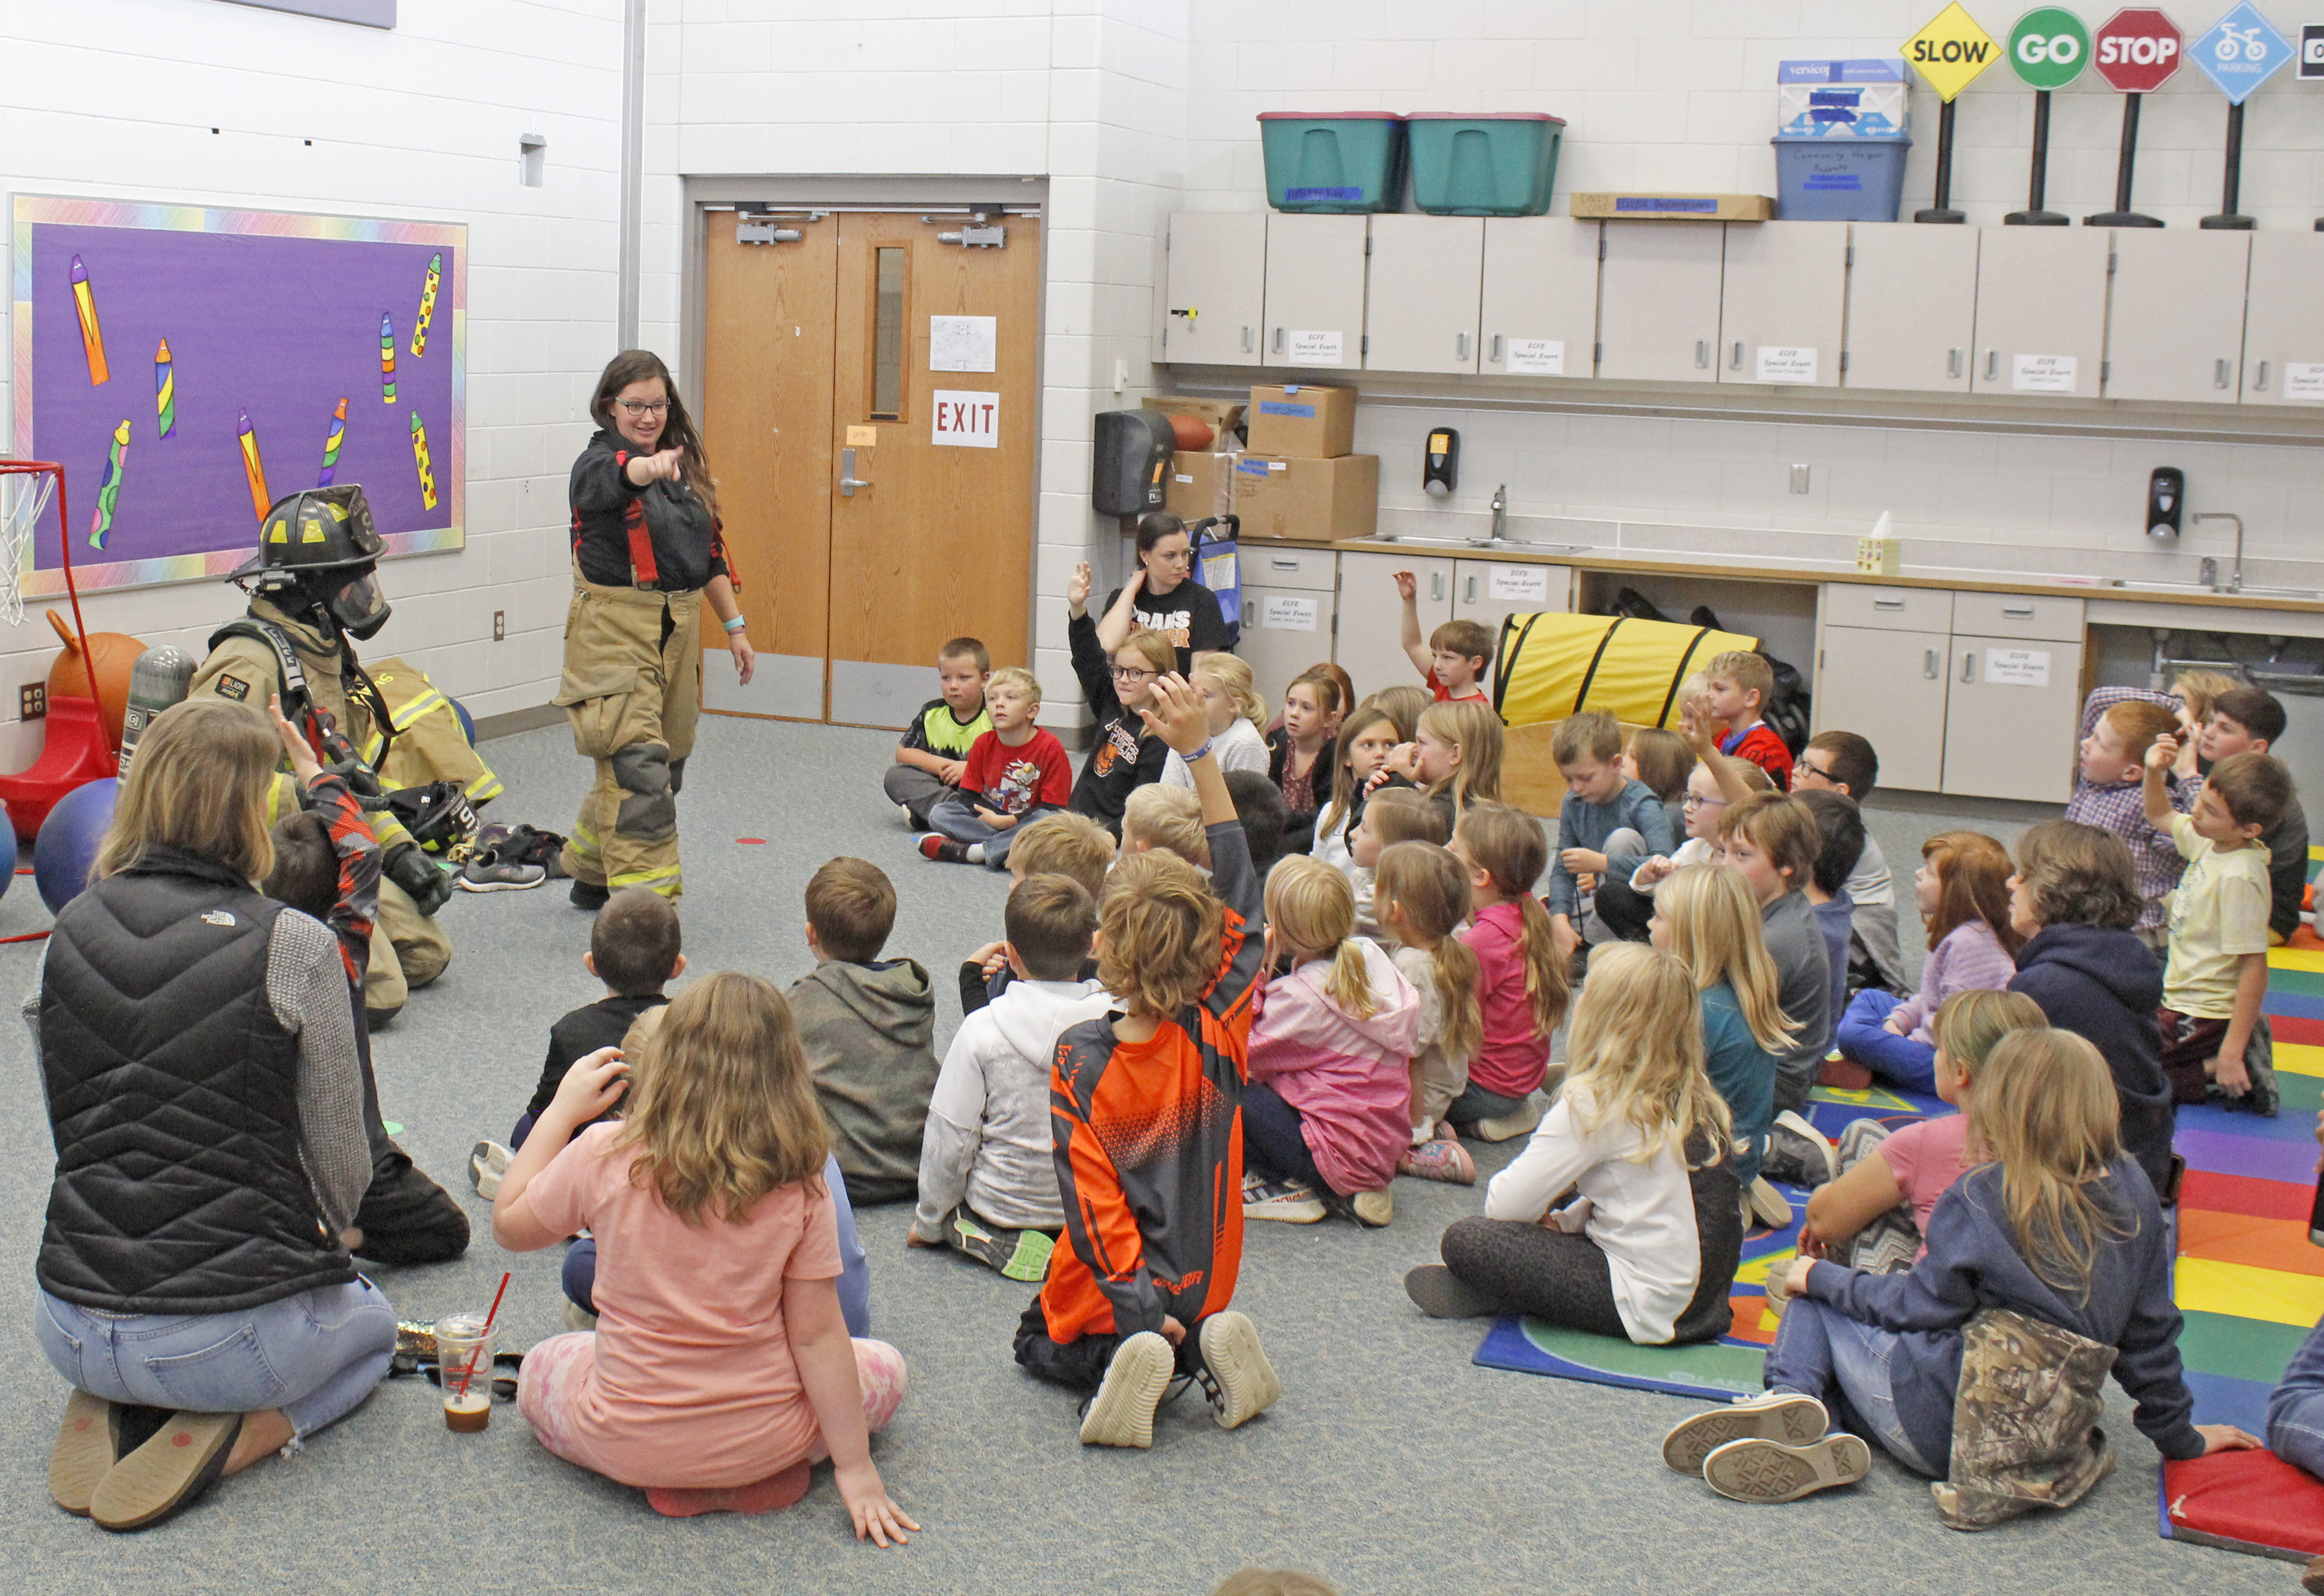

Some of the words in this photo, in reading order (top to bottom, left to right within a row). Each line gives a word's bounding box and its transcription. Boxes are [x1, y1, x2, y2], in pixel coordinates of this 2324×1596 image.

[1913, 40, 1989, 63] SLOW
[2017, 34, 2080, 64] GO
[2099, 36, 2178, 65] STOP
[2217, 62, 2263, 73] PARKING
[937, 402, 994, 434] EXIT
[1496, 578, 1519, 586] Special
[1269, 607, 1291, 616] Special
[459, 806, 476, 829] 9
